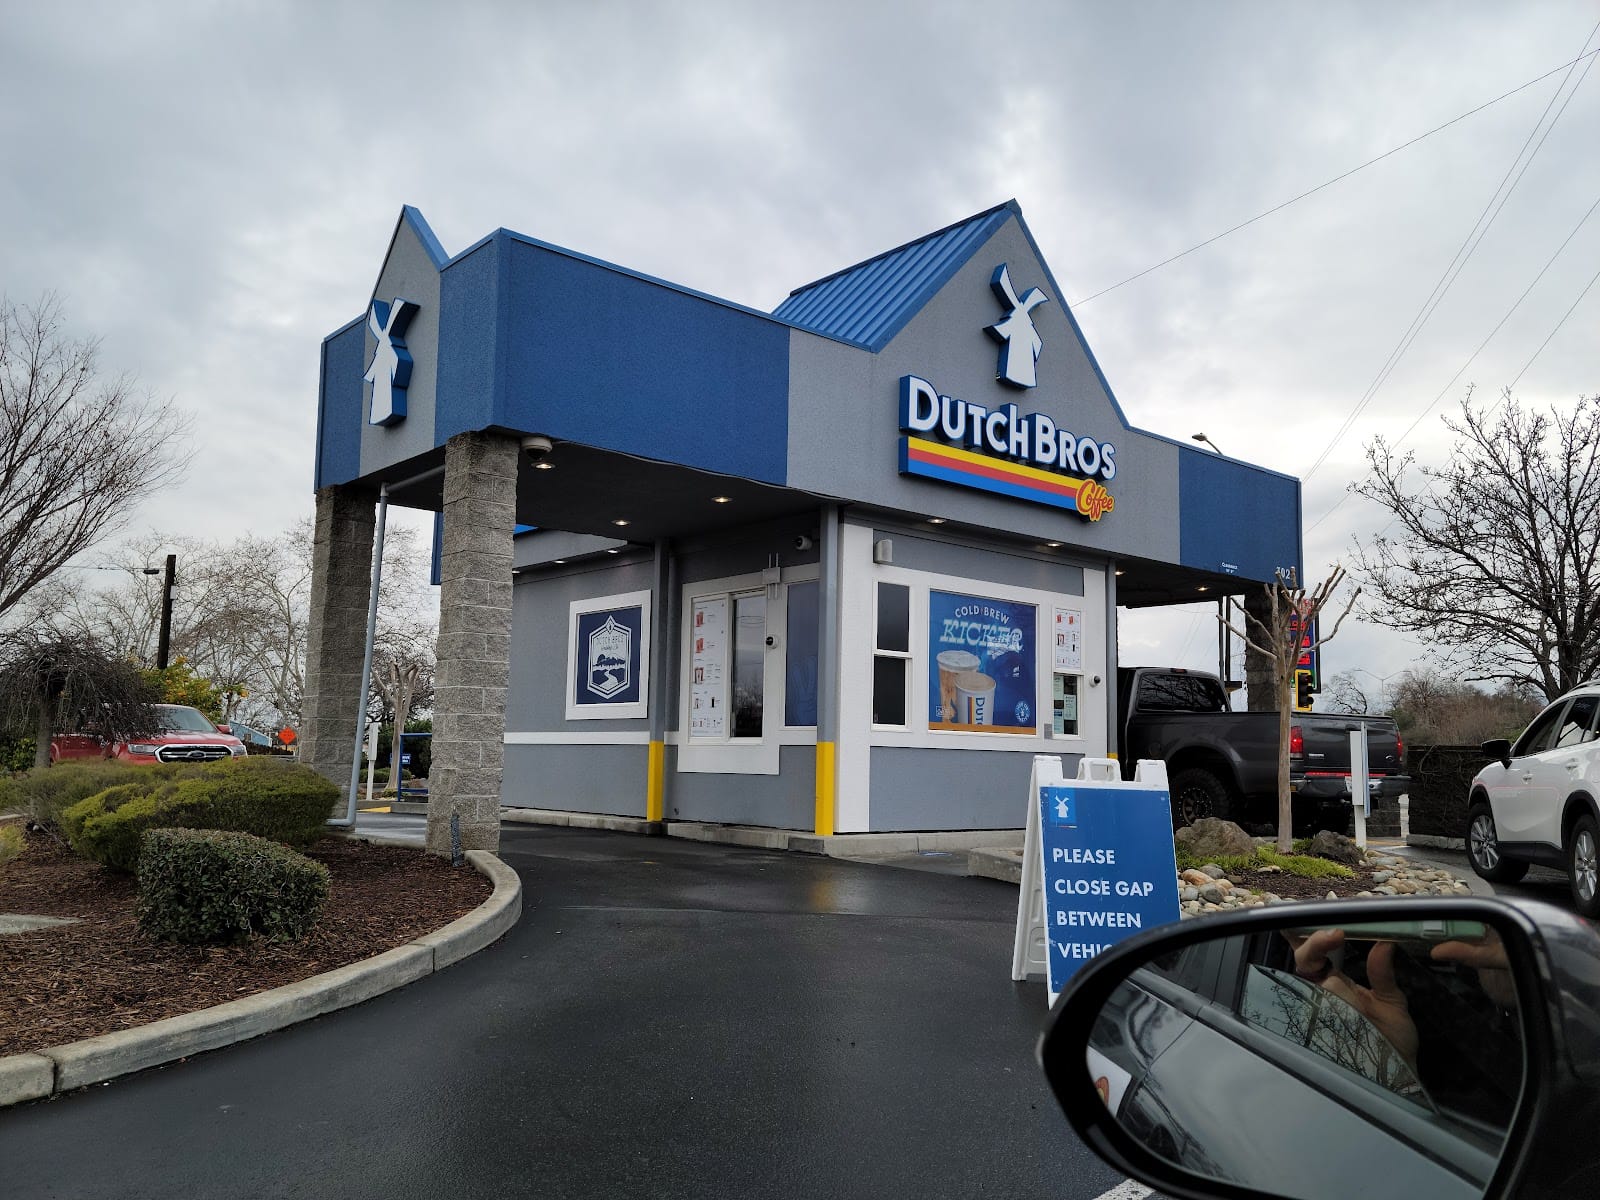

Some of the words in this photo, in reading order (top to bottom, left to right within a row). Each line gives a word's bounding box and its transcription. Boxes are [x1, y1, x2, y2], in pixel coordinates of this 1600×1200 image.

[1076, 479, 1115, 522] Coffee
[955, 604, 980, 618] COLD
[984, 606, 1010, 624] BREW
[939, 618, 1024, 652] KICKER
[1053, 847, 1116, 864] PLEASE
[1054, 879, 1111, 896] CLOSE
[1115, 881, 1154, 897] GAP
[1056, 911, 1142, 928] BETWEEN
